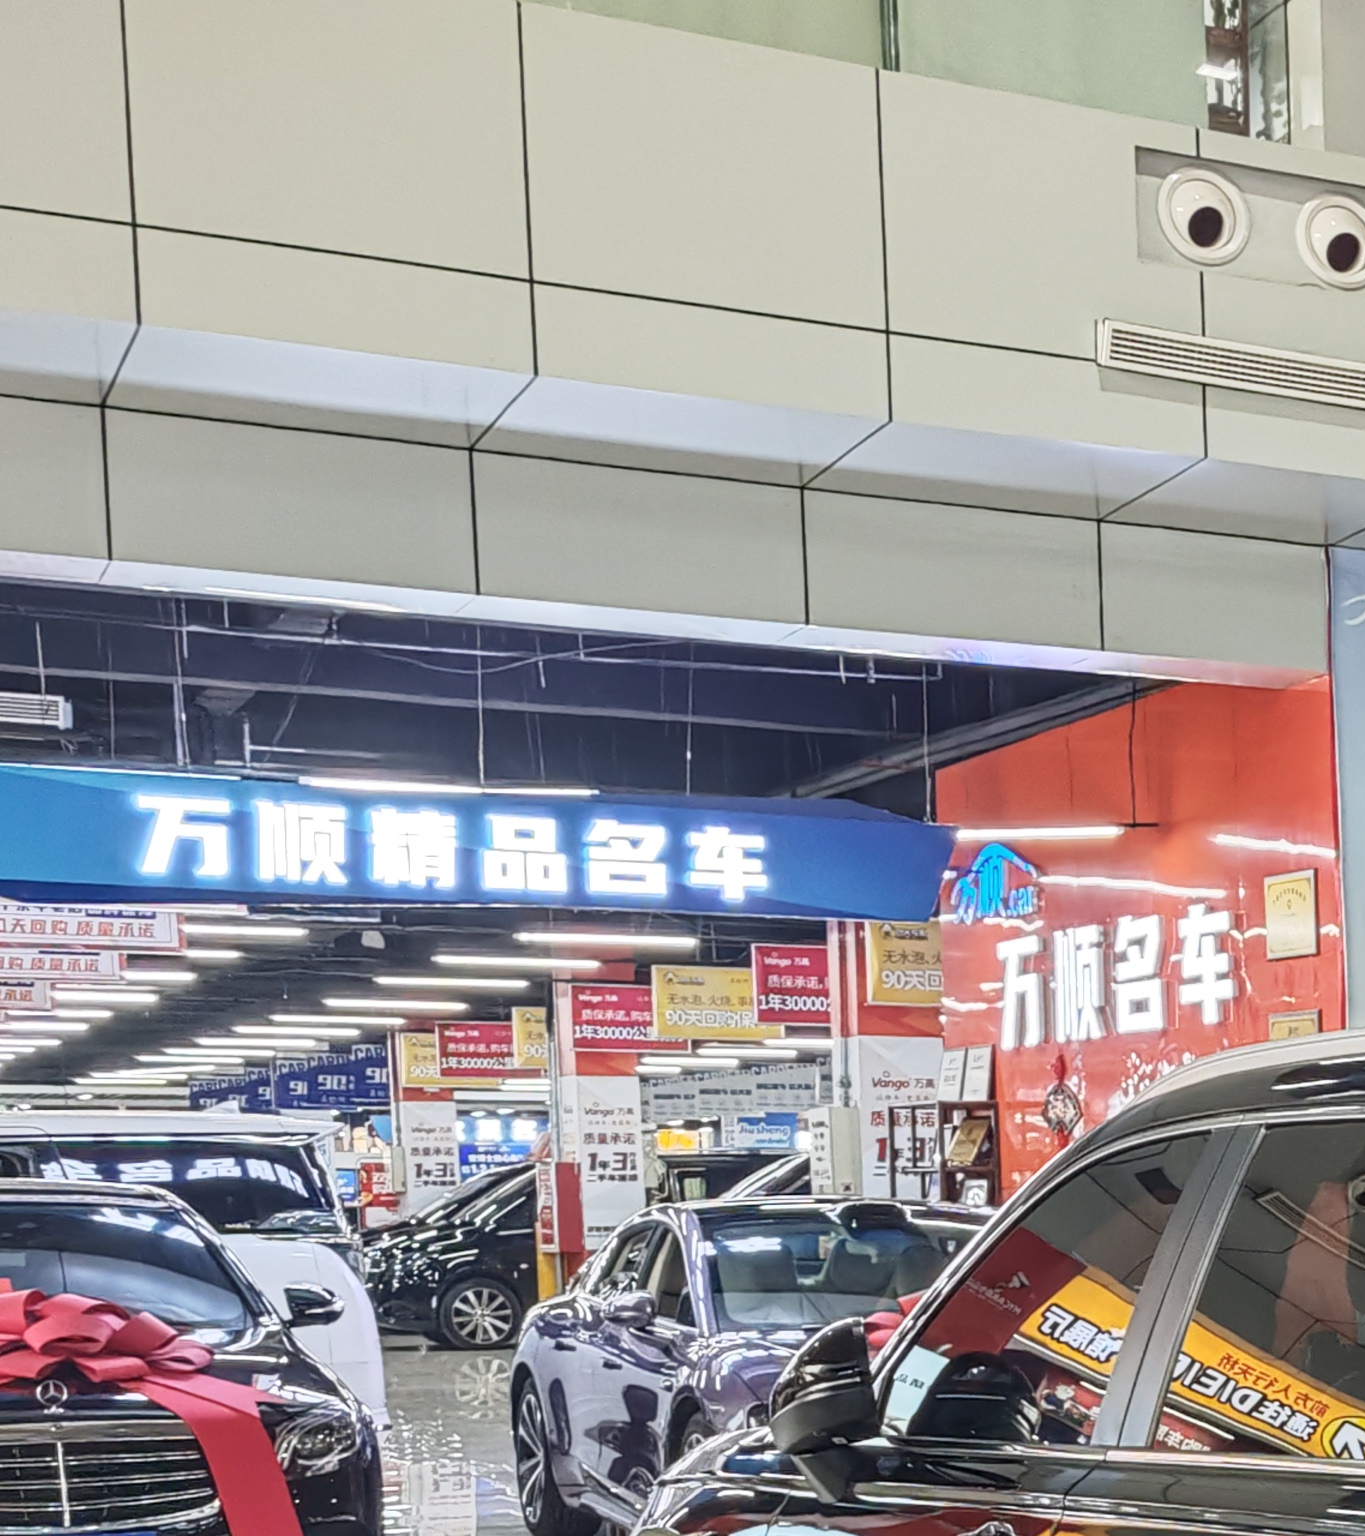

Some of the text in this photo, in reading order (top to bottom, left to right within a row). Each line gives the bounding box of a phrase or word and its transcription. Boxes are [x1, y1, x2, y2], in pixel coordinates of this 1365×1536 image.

[136, 795, 768, 900] 万顺精品名车
[75, 920, 156, 939] 质量承诺
[996, 903, 1237, 1051] 万顺名车
[665, 1009, 756, 1027] 90天回购保
[872, 1077, 911, 1091] Vango
[584, 1107, 615, 1117] Vango
